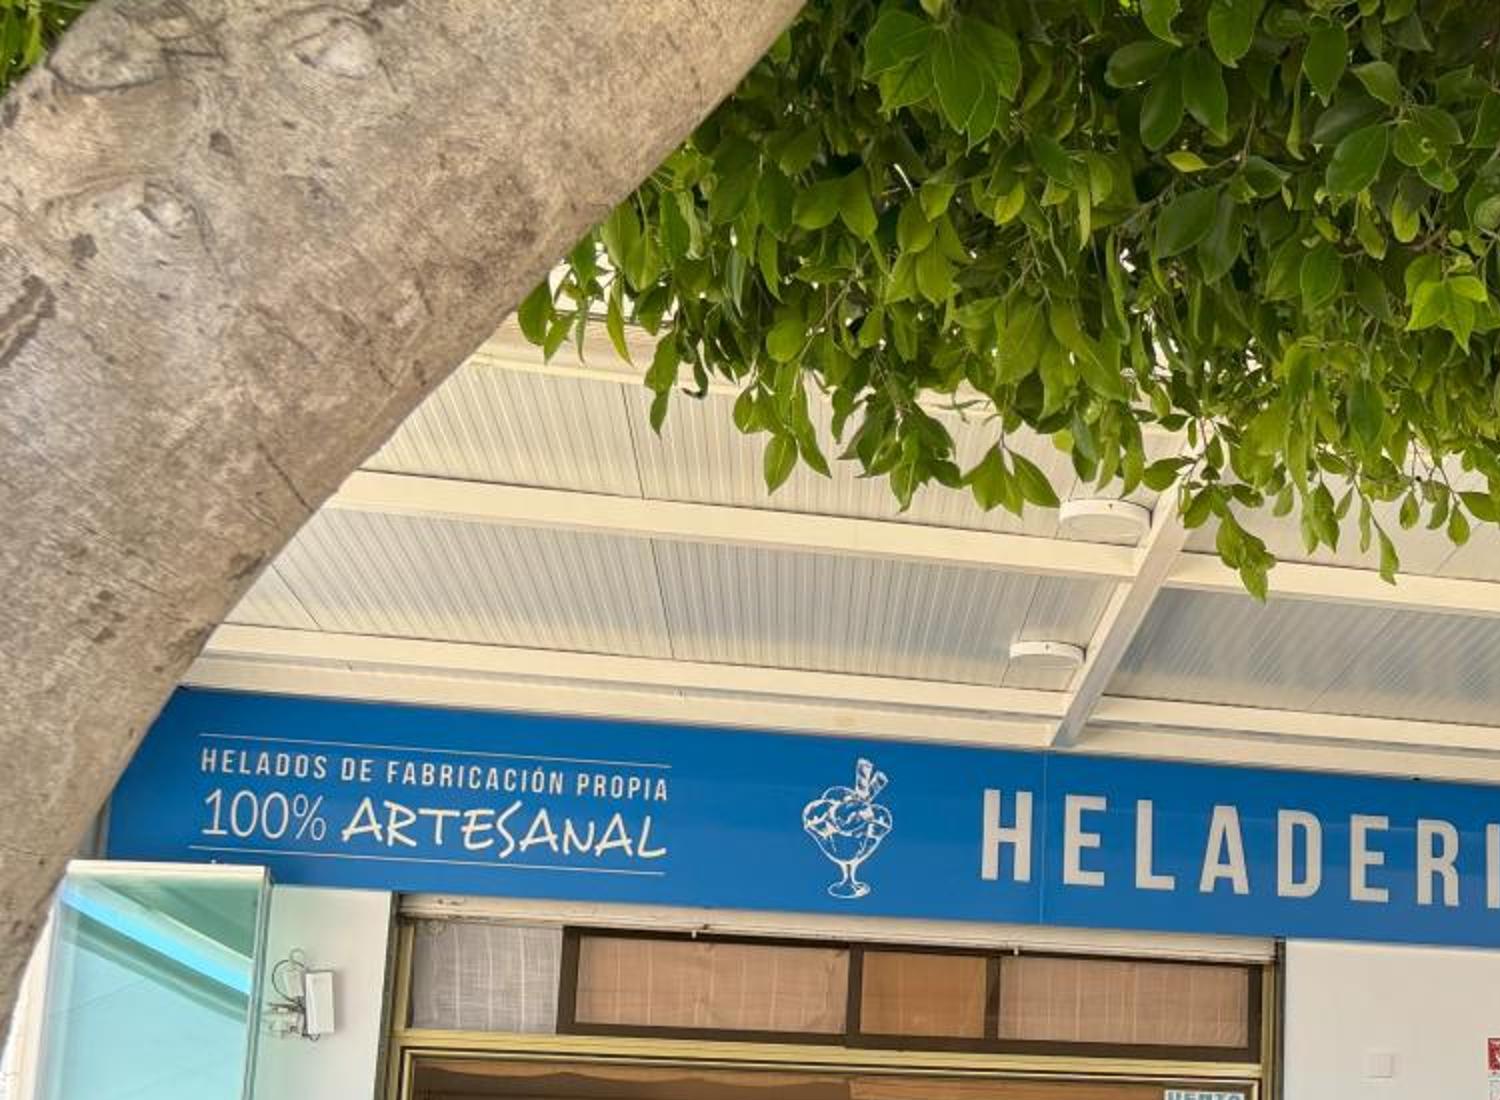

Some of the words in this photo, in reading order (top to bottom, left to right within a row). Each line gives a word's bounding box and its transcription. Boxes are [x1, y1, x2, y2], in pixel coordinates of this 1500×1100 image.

[201, 748, 329, 780] HELADOS
[340, 757, 373, 784] DE
[385, 764, 565, 796] FABRICACIÓN
[576, 775, 670, 801] PROPIA
[202, 789, 327, 841] 100%
[341, 797, 667, 861] ARTESANAL
